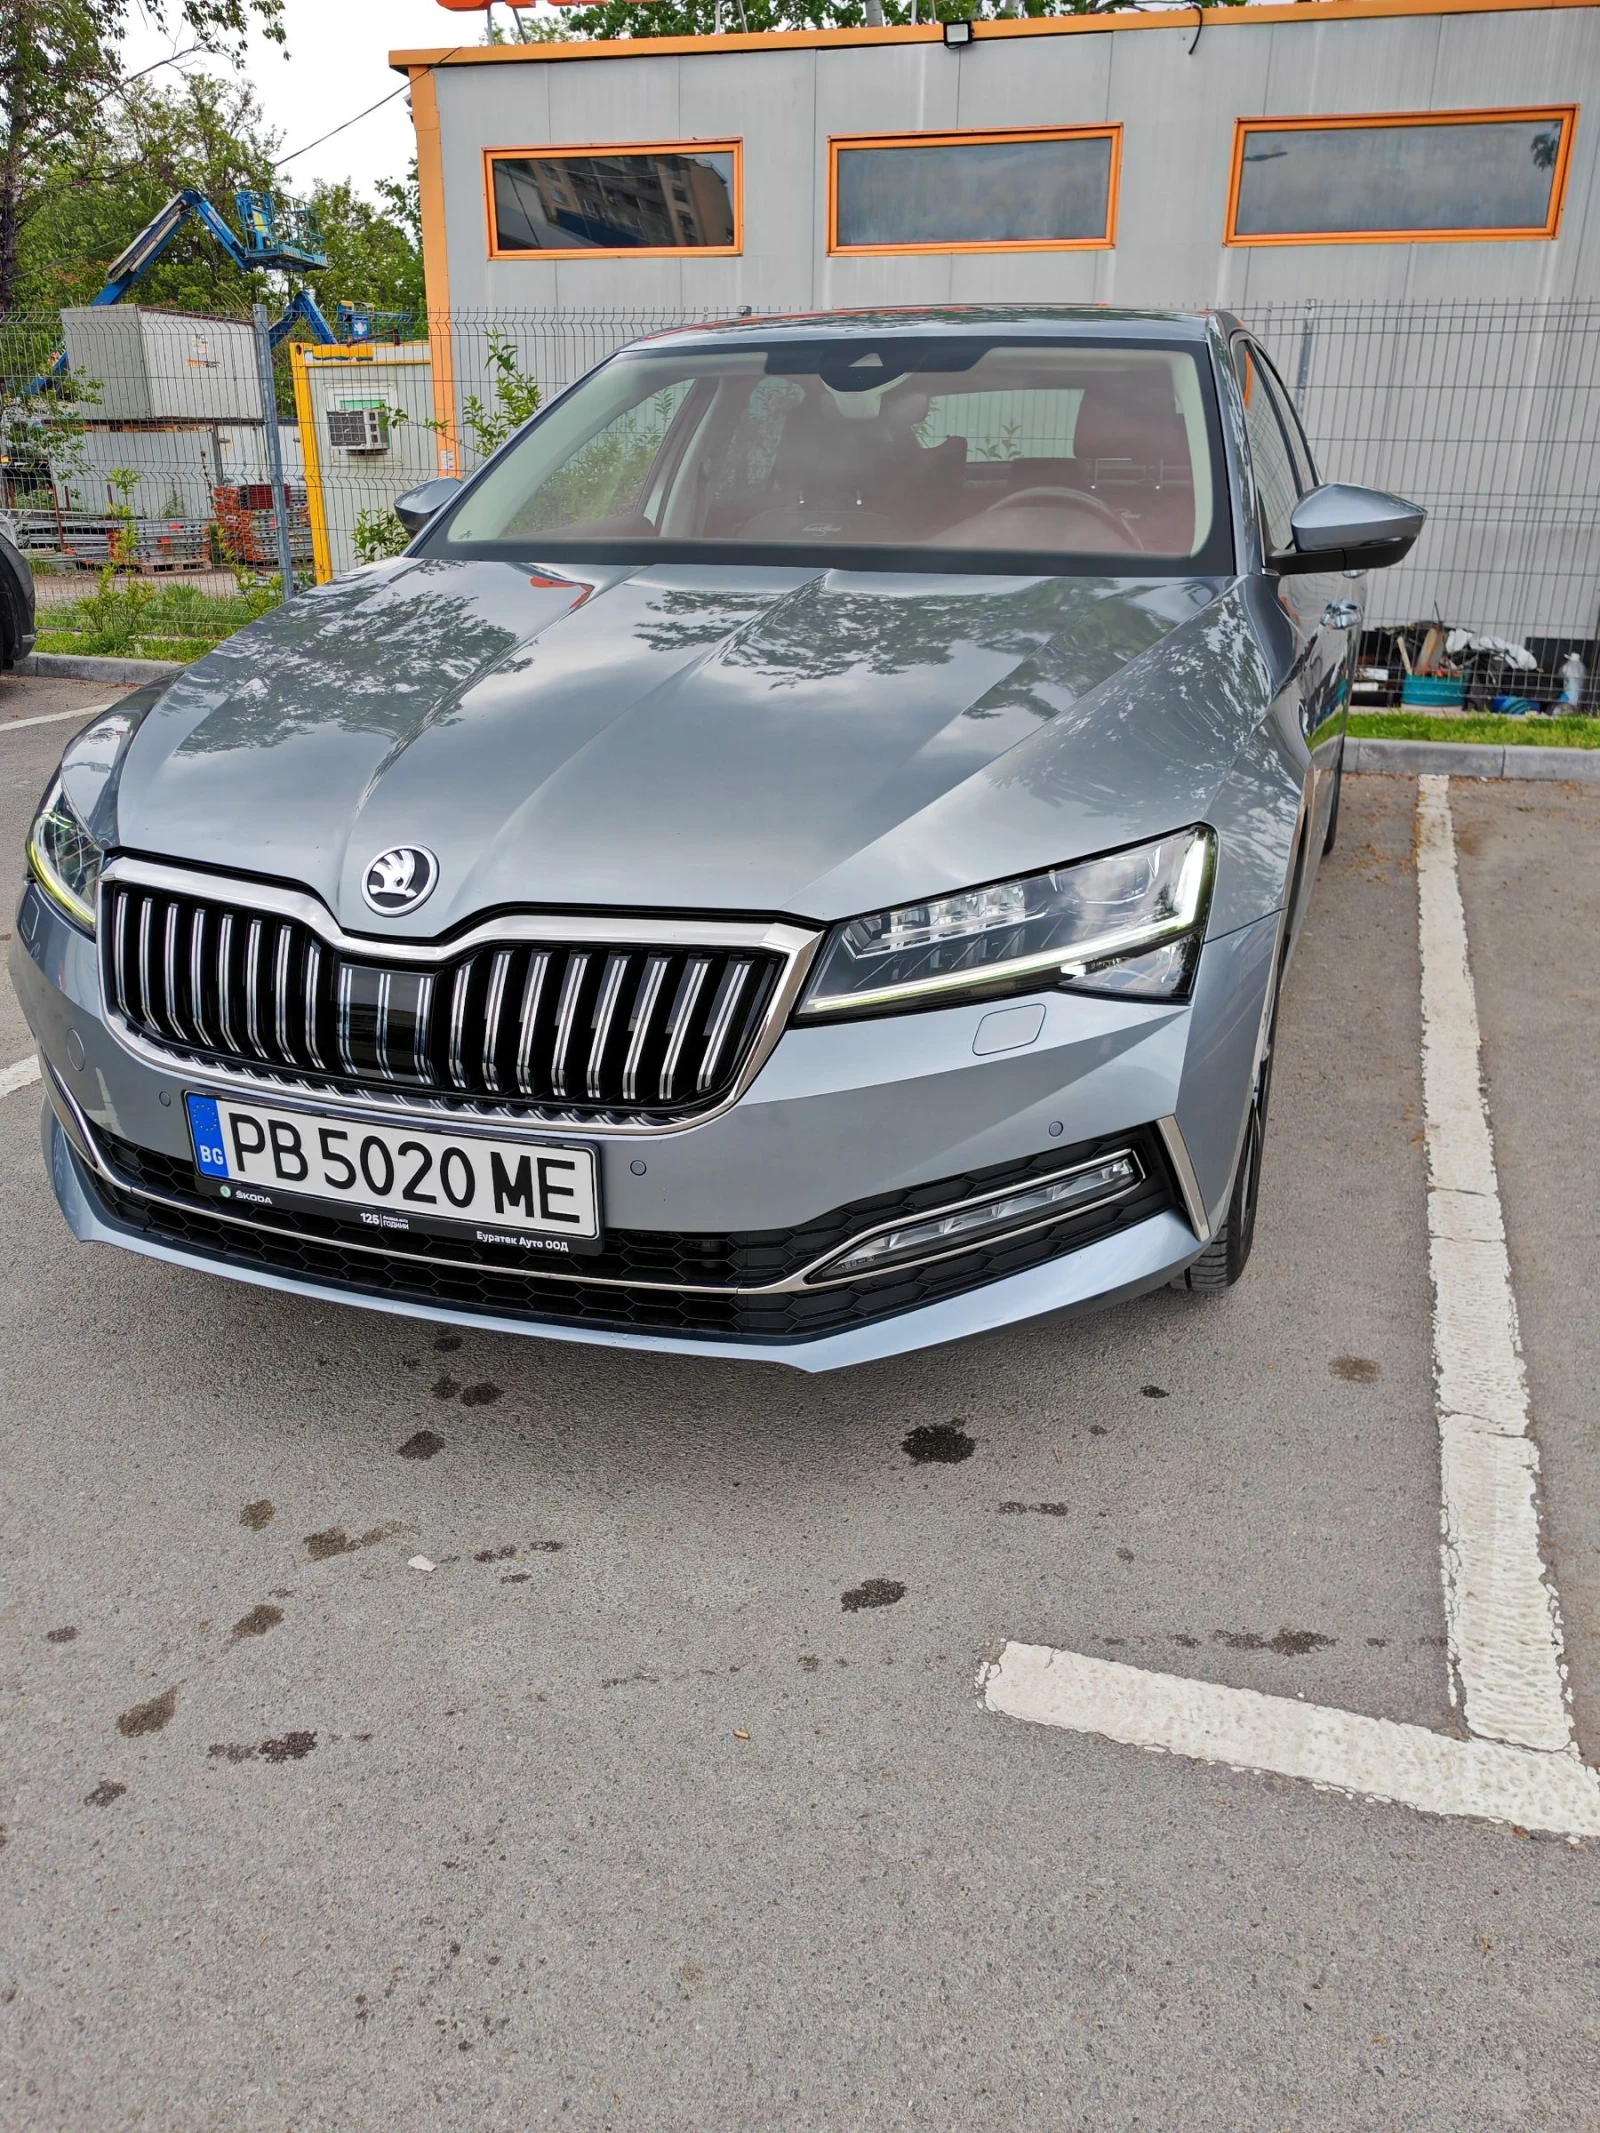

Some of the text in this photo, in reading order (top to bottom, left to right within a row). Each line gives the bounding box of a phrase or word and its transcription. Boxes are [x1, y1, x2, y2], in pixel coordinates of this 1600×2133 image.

[200, 1145, 224, 1165] BG
[228, 1112, 581, 1224] PB 5020 ME
[235, 1190, 273, 1205] ŠKODA
[360, 1212, 380, 1225] 125
[476, 1231, 569, 1252] Еуратек Ауто ООД
